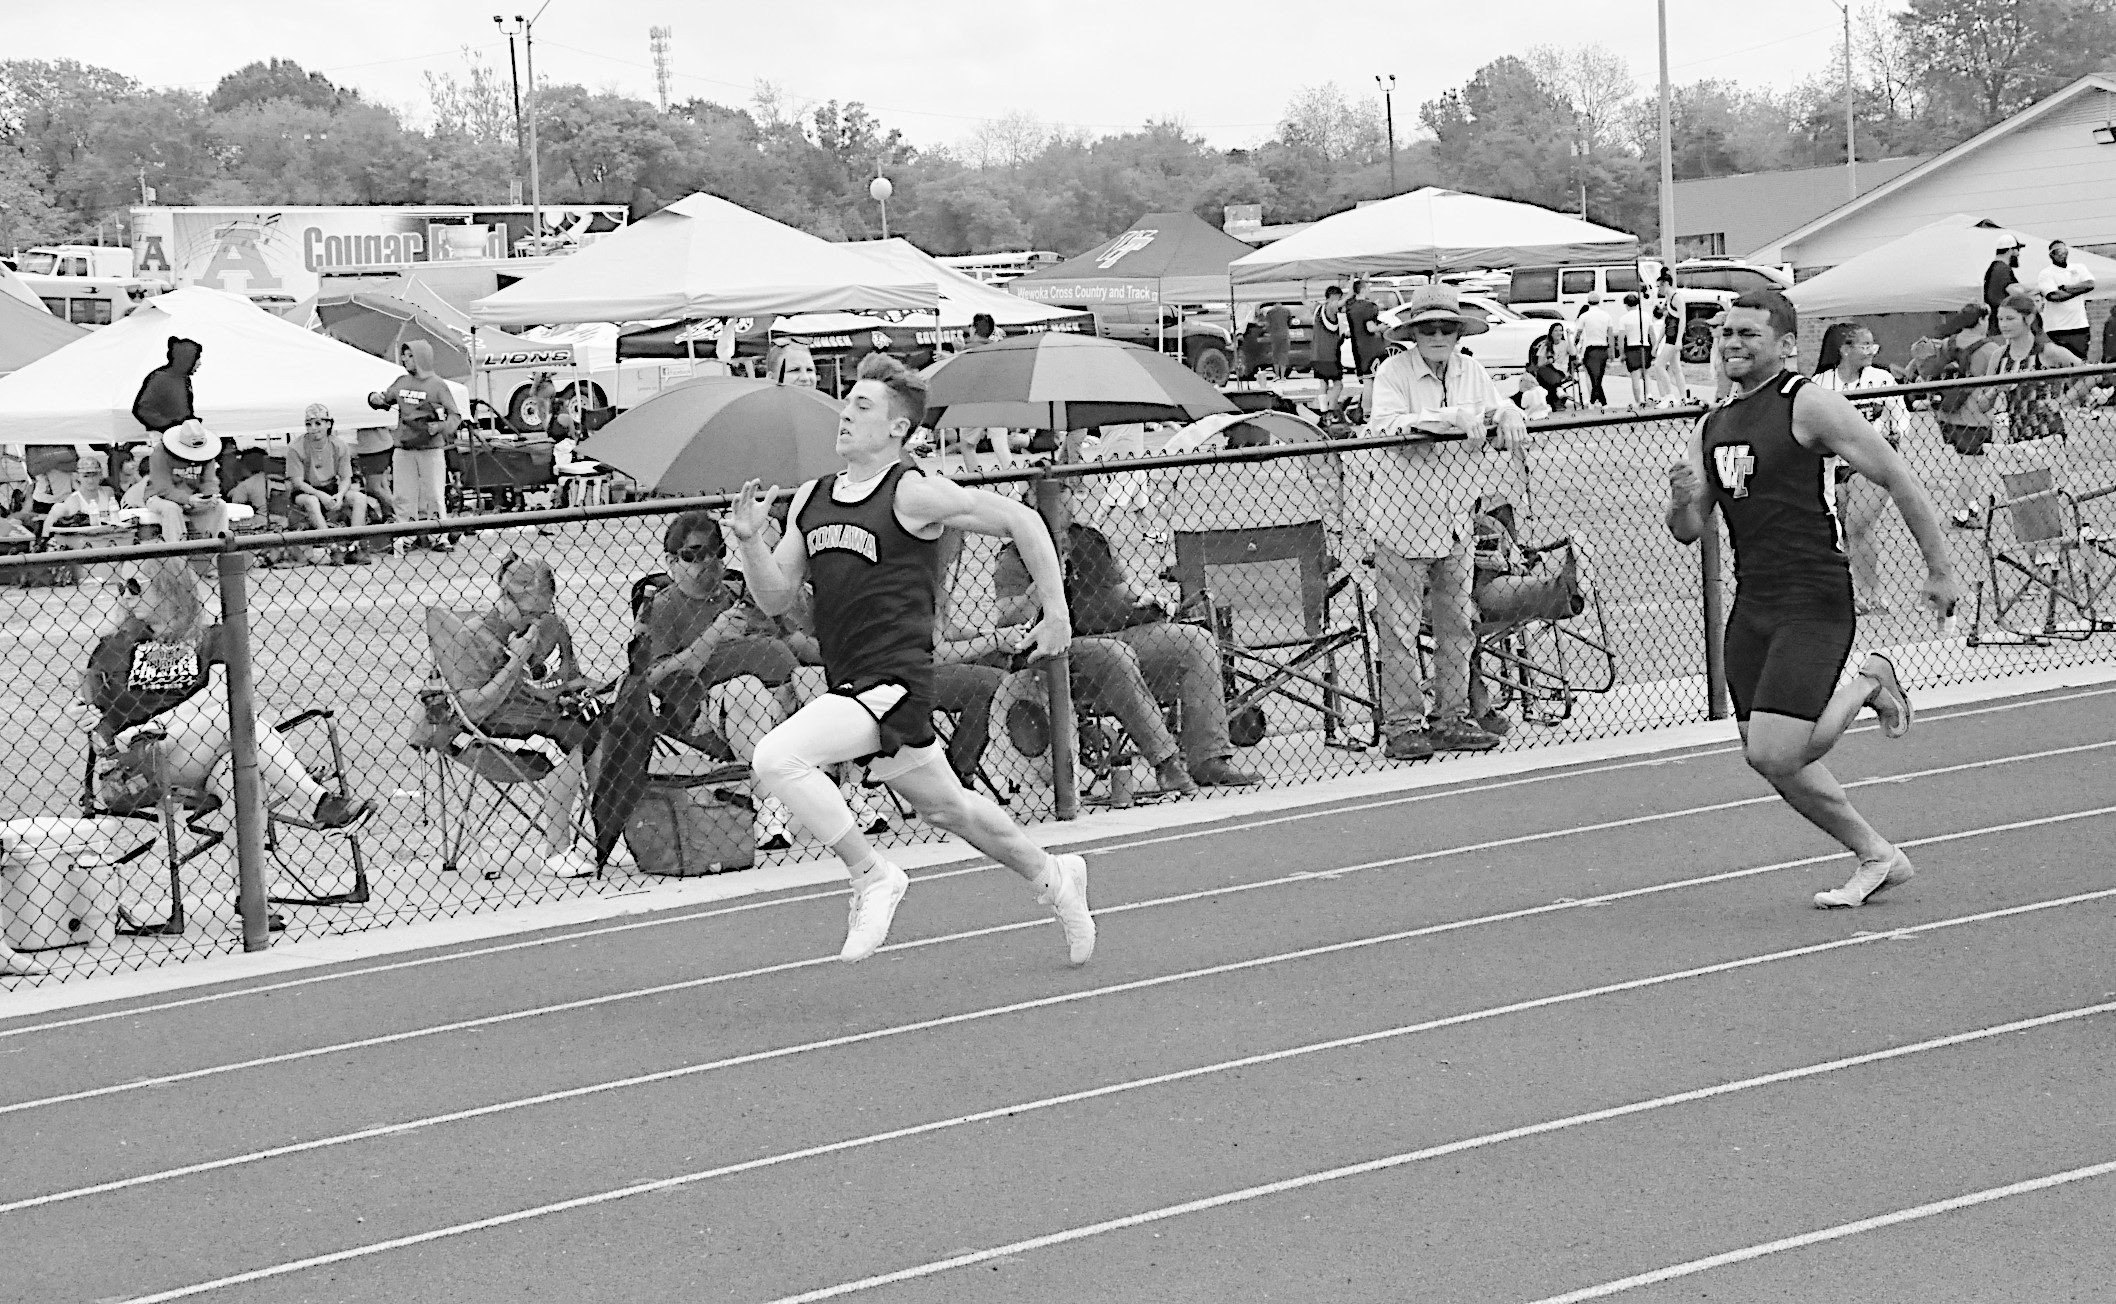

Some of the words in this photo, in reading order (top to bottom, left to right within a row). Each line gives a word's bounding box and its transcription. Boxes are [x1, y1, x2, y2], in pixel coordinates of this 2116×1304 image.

[140, 236, 171, 271] A
[193, 228, 283, 290] A
[1017, 286, 1049, 299] Wewoka
[1050, 286, 1073, 299] Cross
[1075, 285, 1107, 301] Country
[1109, 285, 1125, 299] and
[1127, 285, 1150, 299] Track
[484, 350, 572, 366] LIONS
[807, 524, 877, 562] KONAWA
